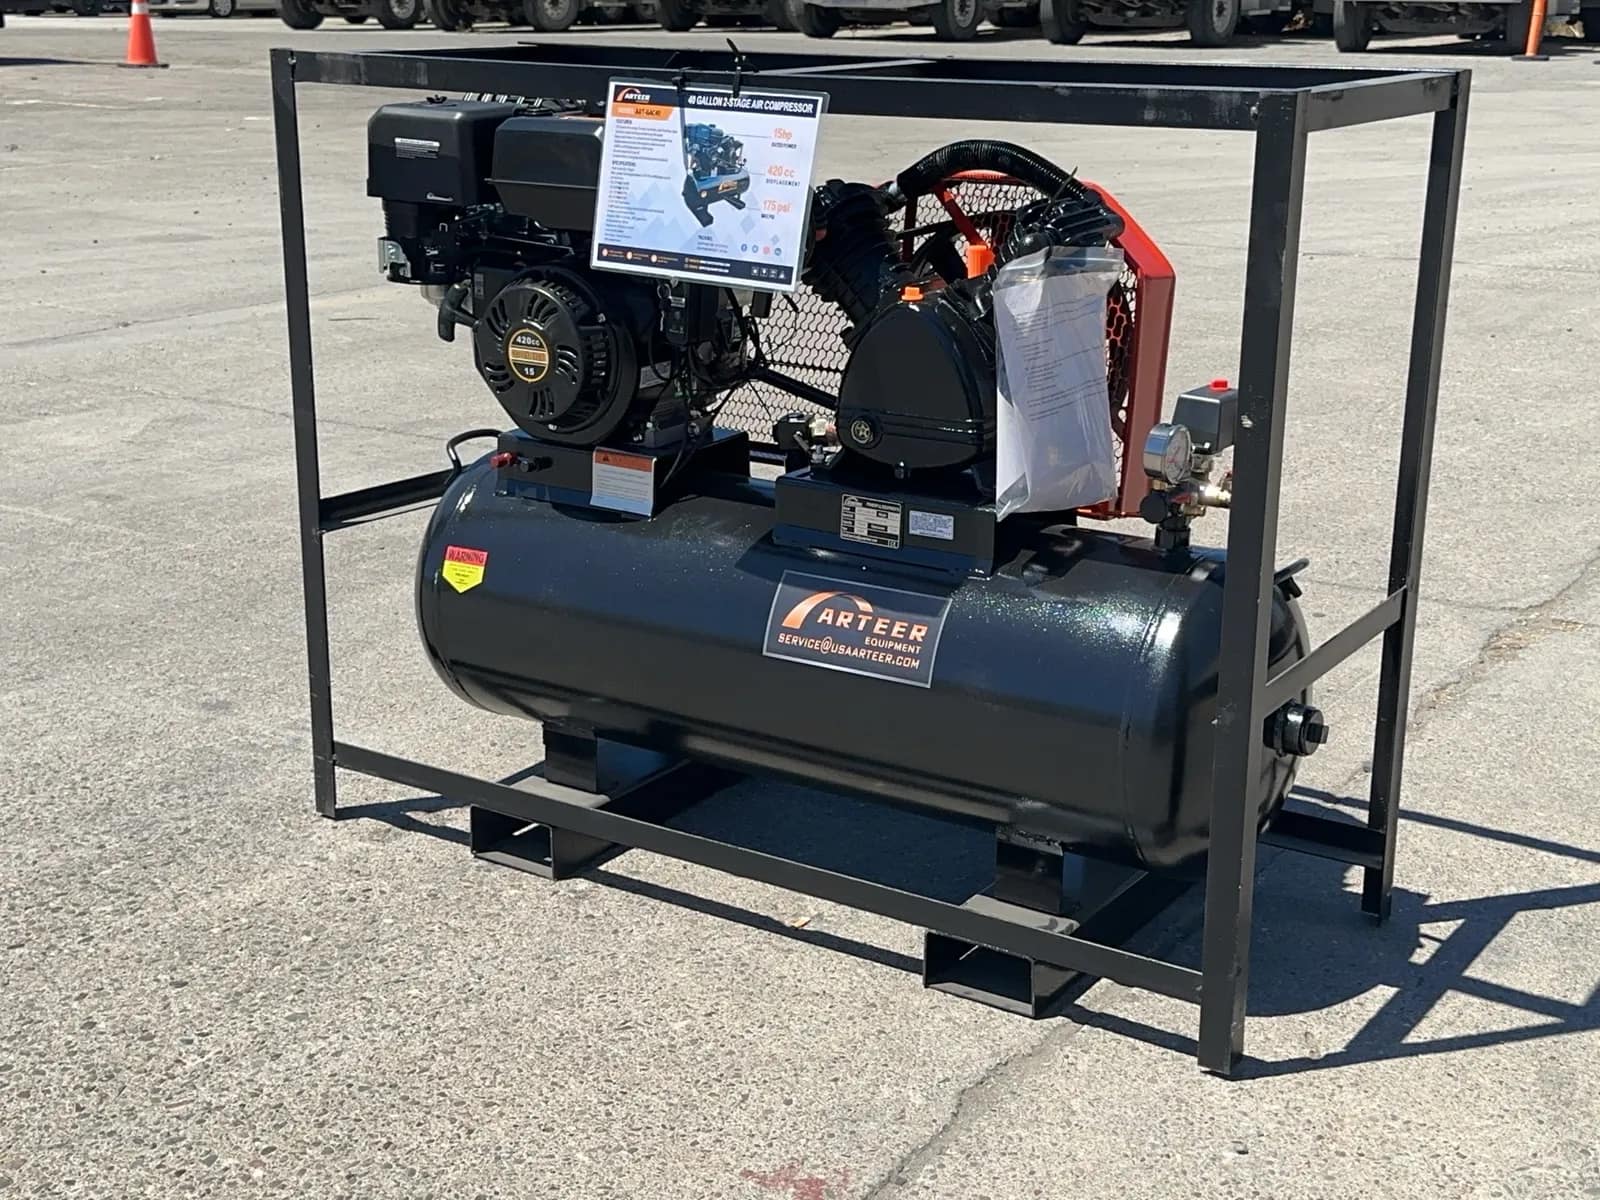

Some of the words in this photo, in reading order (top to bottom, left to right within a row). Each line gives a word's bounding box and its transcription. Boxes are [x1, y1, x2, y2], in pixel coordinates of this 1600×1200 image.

[697, 96, 722, 107] GALLON
[723, 97, 751, 109] 2-STAGE
[751, 100, 764, 110] AIR
[764, 101, 814, 113] COMPRESSOR
[774, 128, 792, 141] 15hp
[768, 165, 783, 177] 420
[784, 169, 796, 178] cc
[763, 200, 776, 211] 175
[777, 202, 791, 214] psi
[516, 335, 540, 346] 420cc
[524, 367, 535, 376] 15
[448, 548, 485, 564] WARNING
[817, 607, 929, 642] ARTEER
[778, 632, 920, 670] SERVICE@USAARTEER.COM
[864, 636, 922, 654] EQUIPMENT
